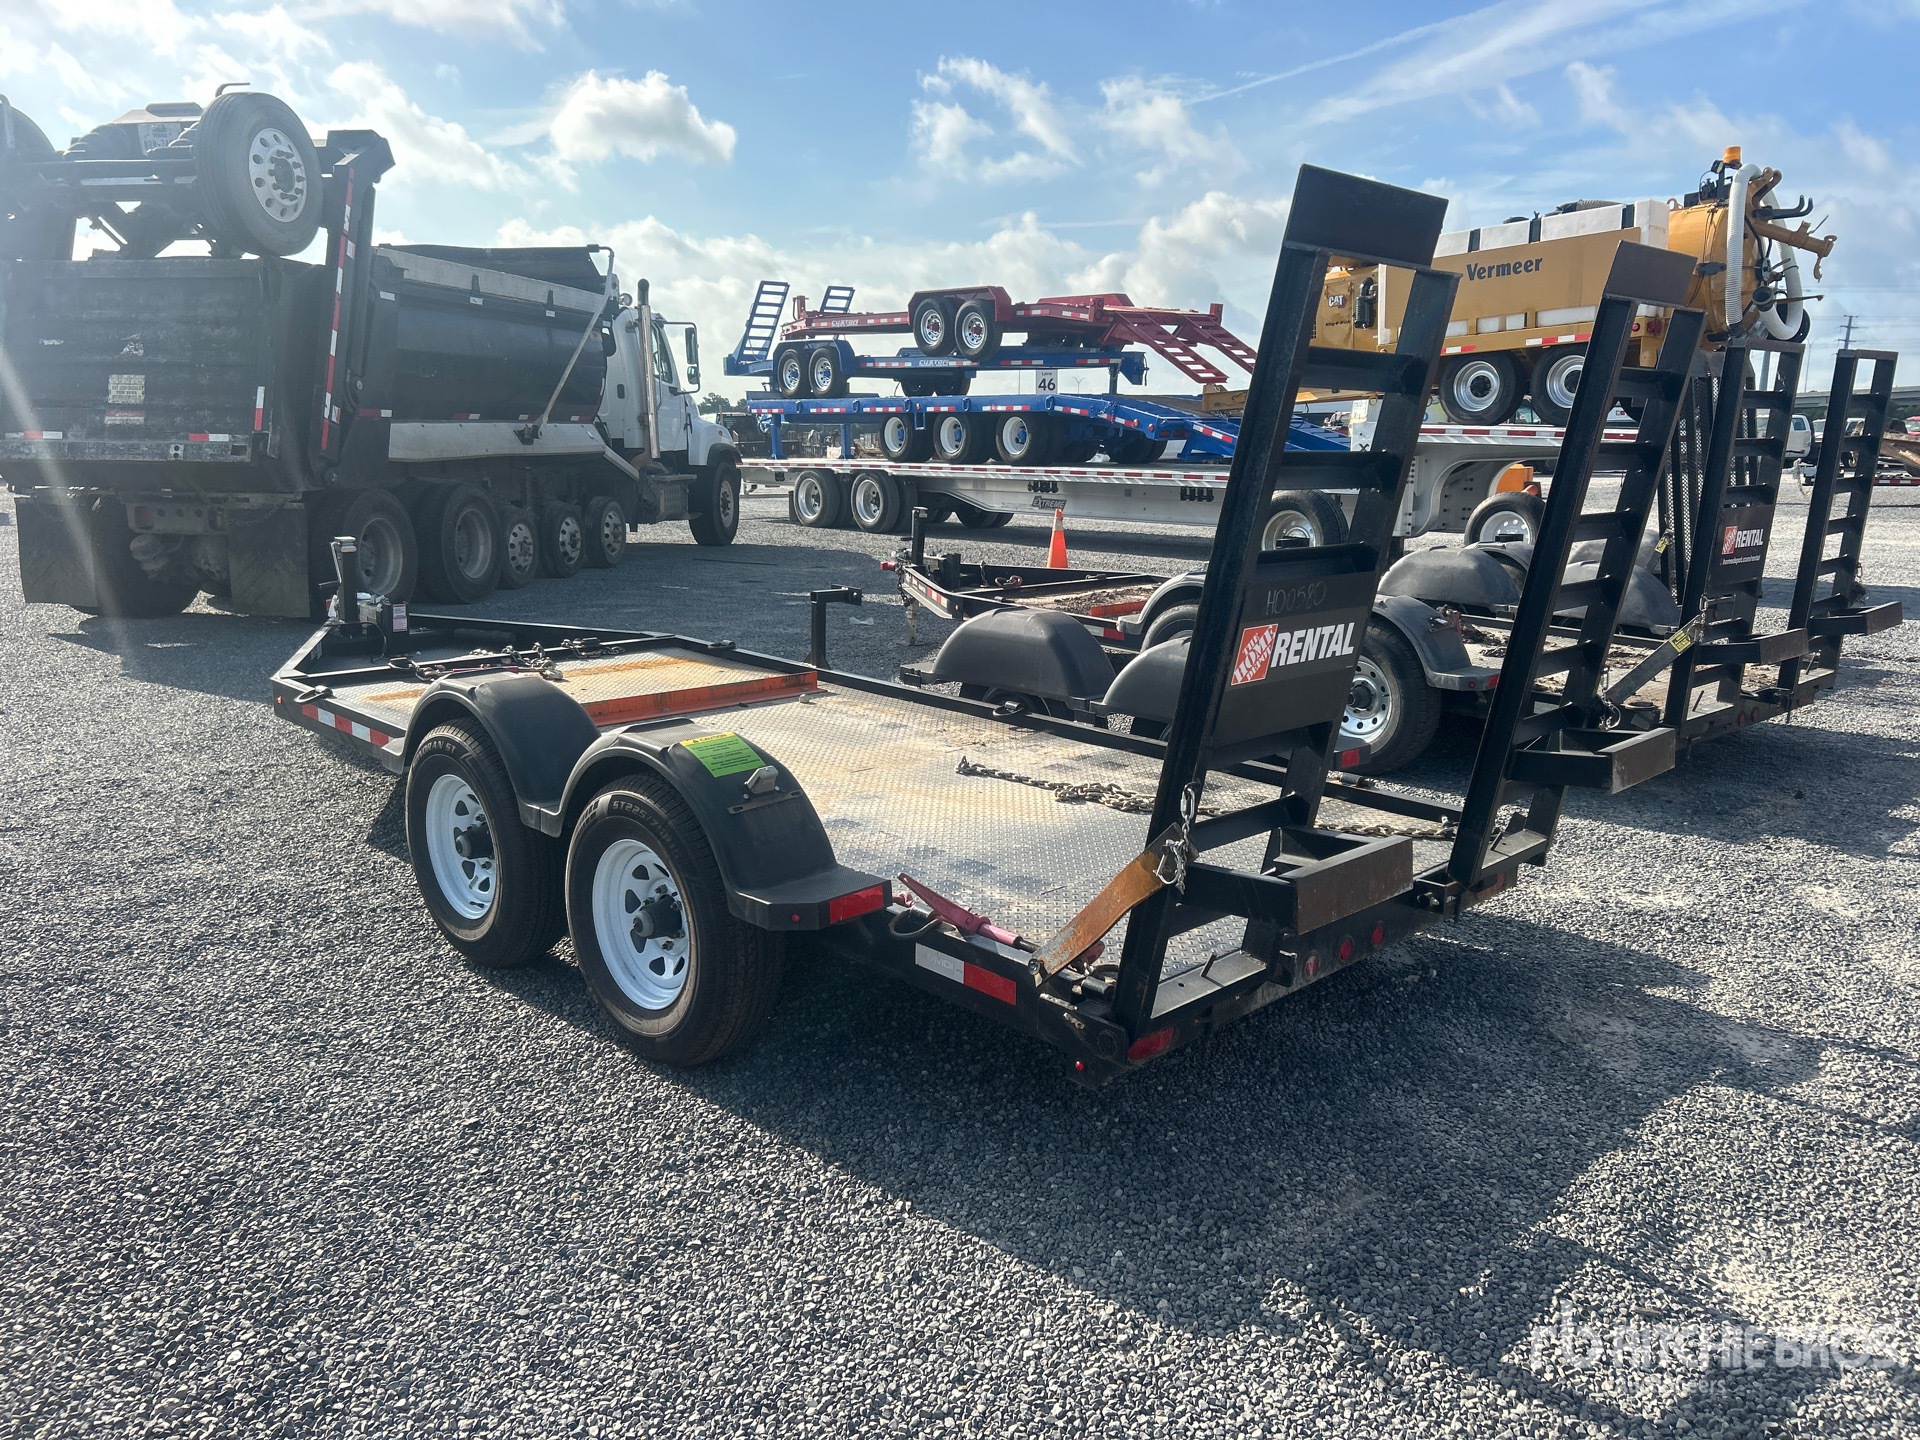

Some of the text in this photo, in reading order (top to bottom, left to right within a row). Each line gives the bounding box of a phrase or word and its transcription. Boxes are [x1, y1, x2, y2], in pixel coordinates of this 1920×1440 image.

[1466, 257, 1543, 281] Vermeer
[1328, 294, 1344, 307] CAT
[831, 319, 859, 327] CUSTOM
[918, 359, 949, 367] CUSTOM
[1037, 378, 1056, 391] 46
[1033, 496, 1066, 509] EXTREME
[1735, 529, 1764, 548] RENTAL
[1242, 632, 1260, 656] THE
[1271, 622, 1355, 668] RENTAL
[1233, 626, 1277, 684] HOME
[1245, 645, 1273, 681] DEPOT
[699, 733, 727, 742] CAUTION
